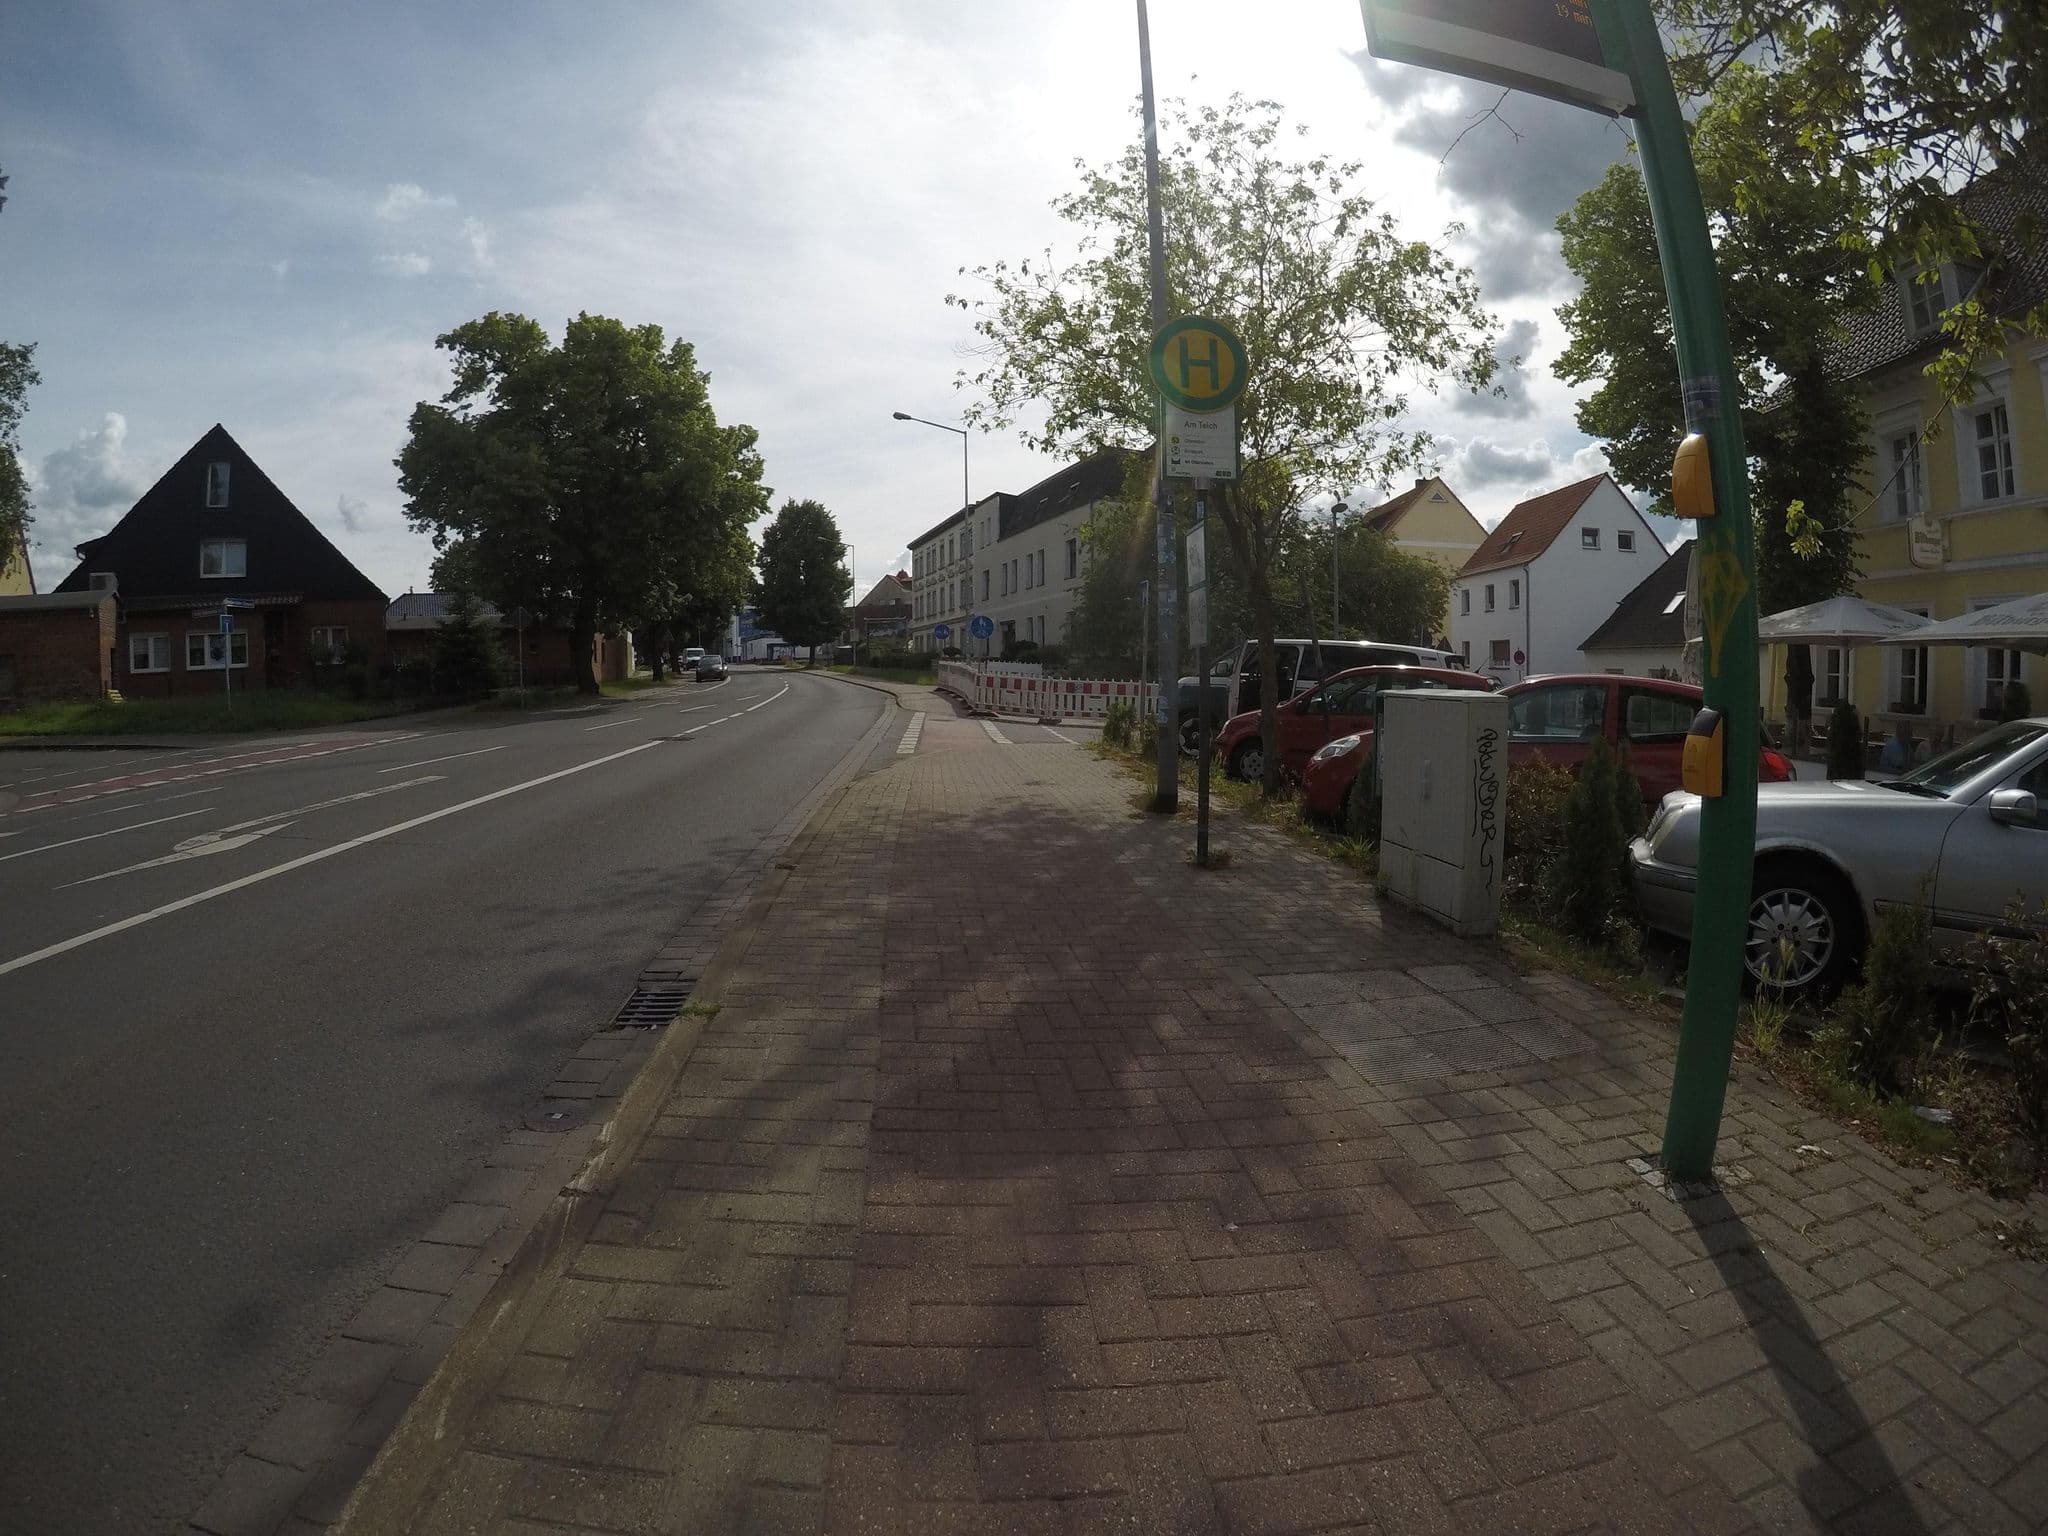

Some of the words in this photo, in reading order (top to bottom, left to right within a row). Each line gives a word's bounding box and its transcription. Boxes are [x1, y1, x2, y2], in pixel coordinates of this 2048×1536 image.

[1573, 11, 1593, 26] min
[1179, 336, 1219, 391] H
[1184, 420, 1197, 429] Am
[1199, 421, 1218, 430] Teich
